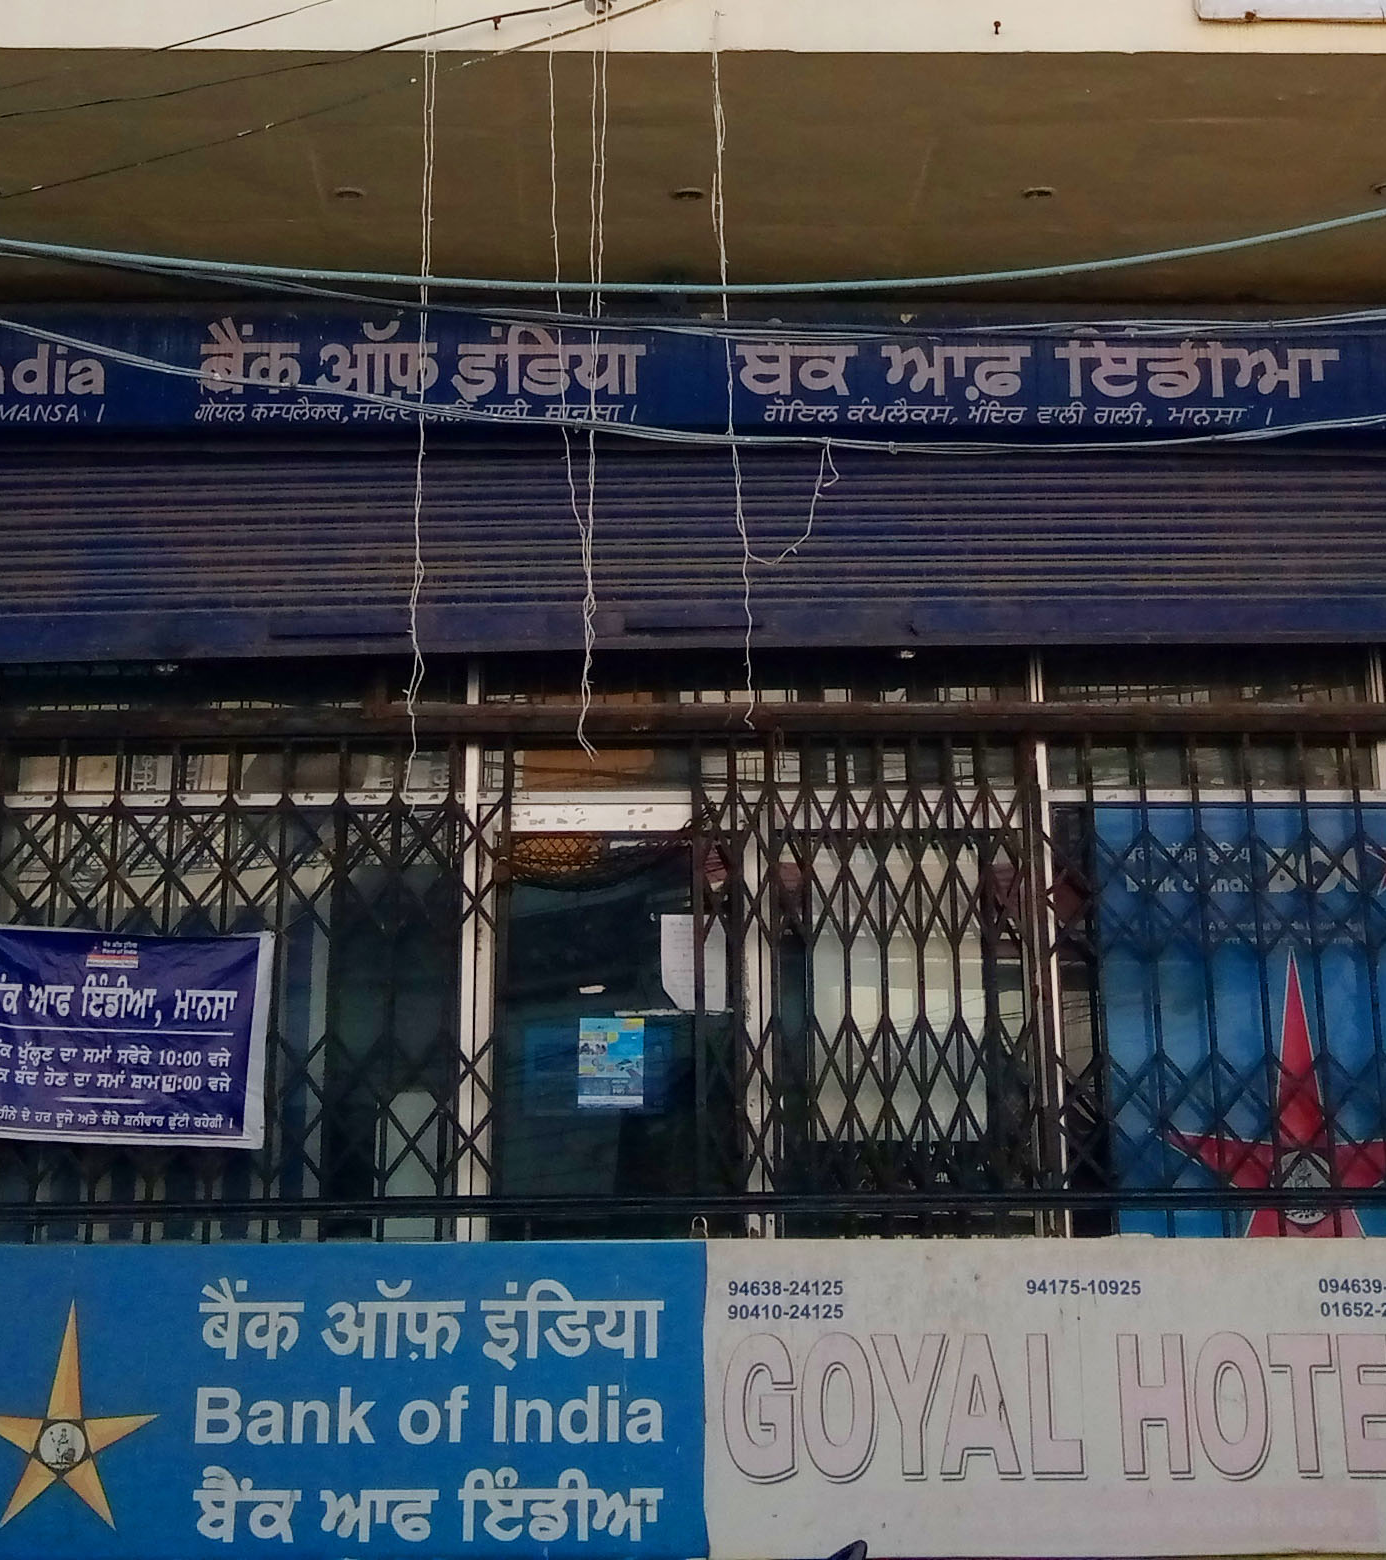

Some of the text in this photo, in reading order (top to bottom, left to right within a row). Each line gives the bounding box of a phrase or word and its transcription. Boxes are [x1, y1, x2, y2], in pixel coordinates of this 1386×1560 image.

[199, 316, 302, 395] बैंक
[451, 324, 647, 403] इंडिया
[1037, 401, 1087, 425] ਵਾਲੀ
[29, 985, 75, 1017] ਆਫ
[81, 974, 163, 1028] ਇੰਡੀਆ,
[174, 988, 238, 1022] ਮਾਨਸਾ
[59, 1047, 79, 1062] ਦਾ
[83, 1044, 113, 1064] ਸਮਾਂ
[116, 1044, 153, 1065] ਸਵੇਰੇ
[158, 1049, 202, 1066] 10:00
[207, 1046, 232, 1068] ਵਜੇ
[14, 1065, 40, 1086] ਬੰਦ
[43, 1065, 70, 1087] ਹੋਣ
[73, 1071, 93, 1088] ਦਾ
[96, 1069, 126, 1089] ਸਮਾਂ
[207, 1071, 232, 1093] ਵਜੇ
[21, 1106, 31, 1122] ਦੇ
[35, 1111, 53, 1123] ਹਰ
[727, 1278, 845, 1298] 94638-24125
[1025, 1278, 1143, 1298] 94175-10925
[198, 1277, 665, 1370] बैंक ऑफ़ इंडिया
[726, 1302, 845, 1321] 90410-24125
[193, 1385, 664, 1445] Bank of India
[721, 1331, 1088, 1485] GOYAL
[193, 1465, 664, 1544] ਬੈਂਕ ਆਫ ਇੰਡੀਆ
